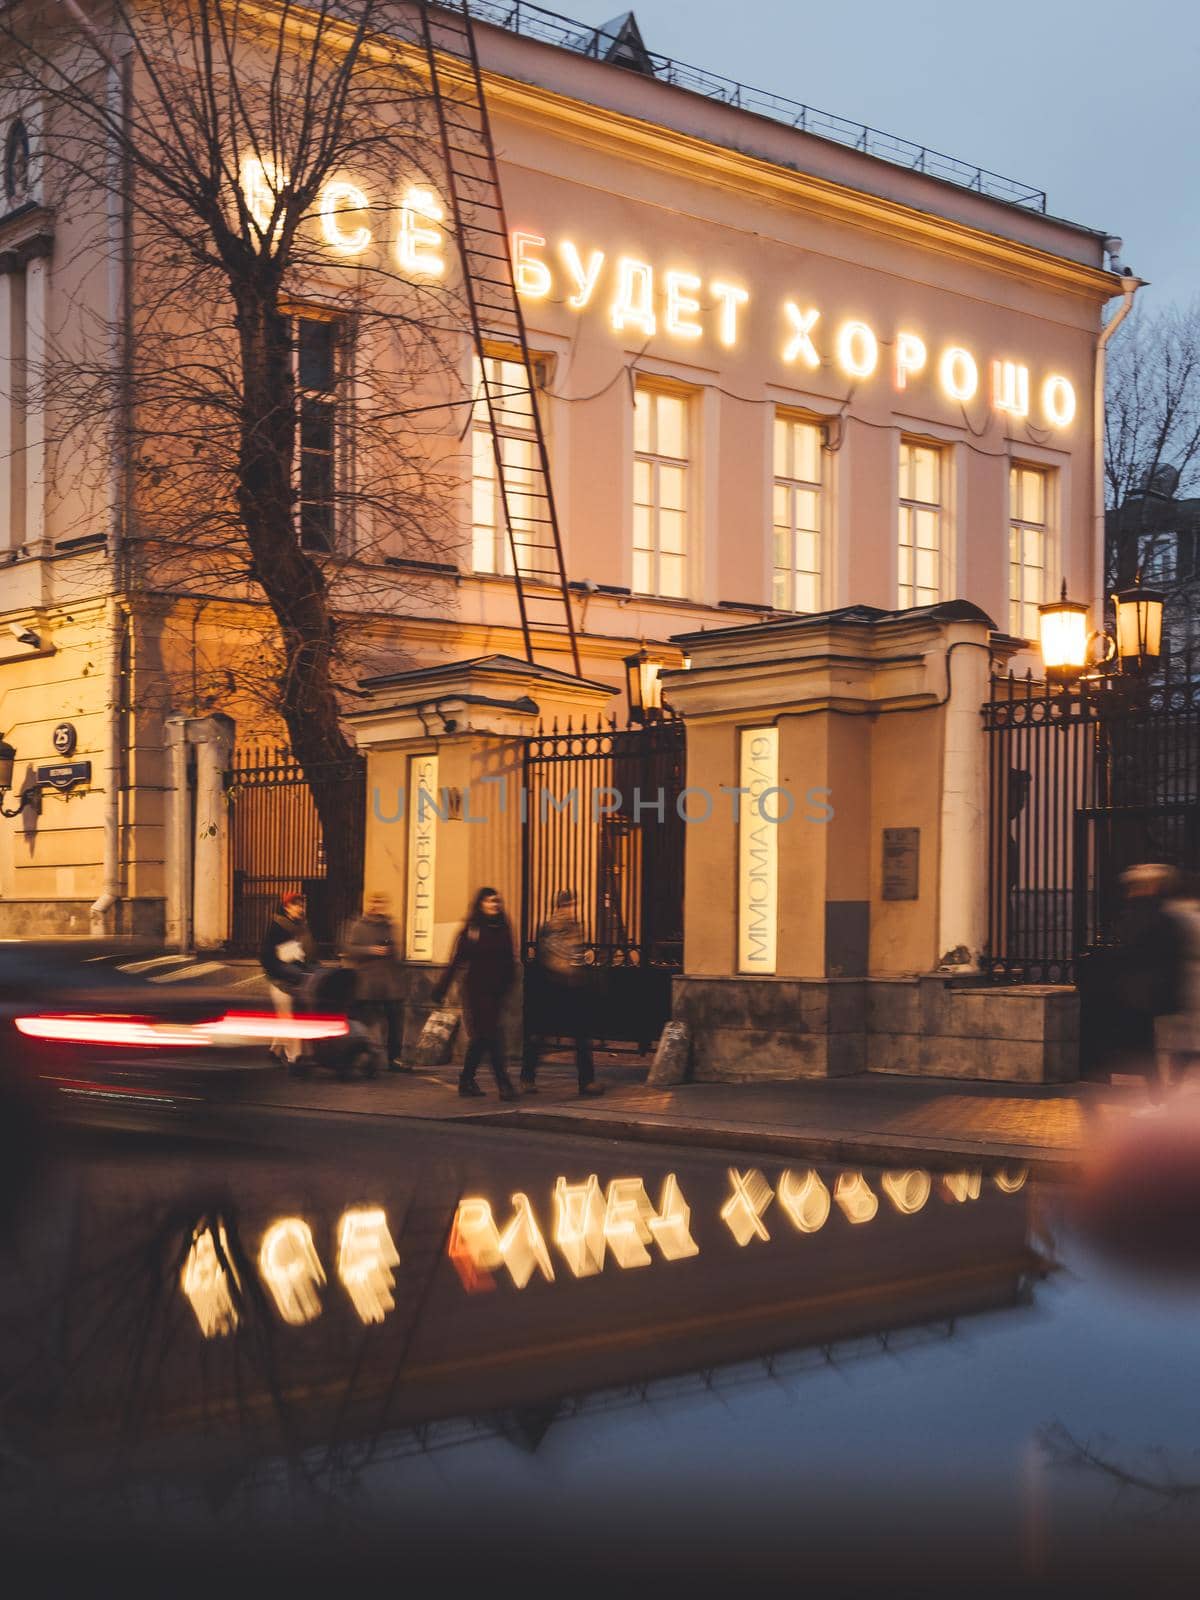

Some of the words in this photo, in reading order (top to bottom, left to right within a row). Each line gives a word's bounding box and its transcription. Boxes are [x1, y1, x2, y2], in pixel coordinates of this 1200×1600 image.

[511, 231, 749, 346] БУДЕТ
[782, 300, 1077, 427] ХОРОШО
[55, 727, 69, 745] 25
[747, 825, 769, 961] MMOMA
